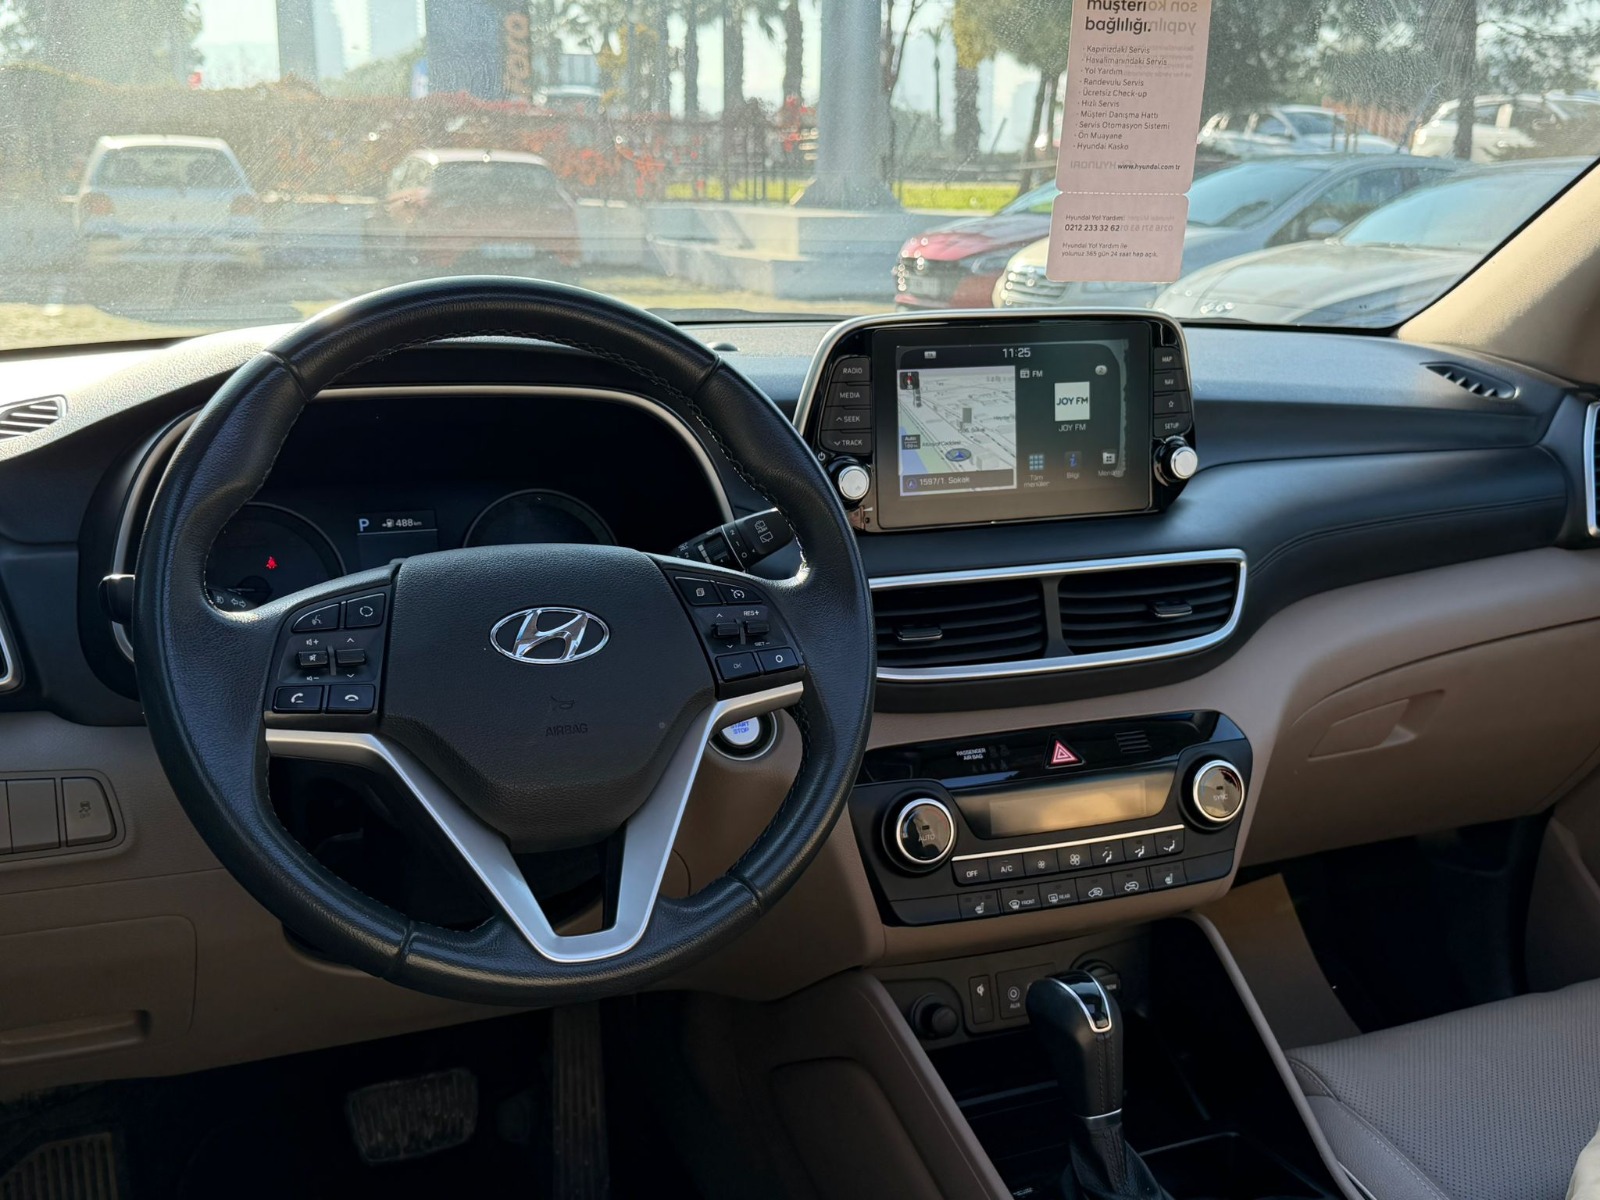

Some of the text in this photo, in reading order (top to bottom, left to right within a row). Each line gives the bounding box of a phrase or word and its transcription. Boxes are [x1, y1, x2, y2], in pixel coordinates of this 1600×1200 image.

[1085, 16, 1151, 35] bağlılığı.
[1129, 46, 1150, 54] Servis
[1146, 57, 1167, 66] Servis
[1084, 67, 1096, 75] Yol
[1097, 67, 1123, 75] Yardım
[1083, 78, 1121, 86] Randevulu
[1079, 120, 1170, 130] Servis Otomasyon Sistemi
[1064, 223, 1120, 232] 0212 233 32 62
[1002, 347, 1031, 358] 11:25
[842, 367, 863, 375] RADIO
[1032, 370, 1043, 378] FM
[1056, 396, 1089, 406] JOY FM
[1058, 423, 1087, 432] JOY FM
[1164, 422, 1179, 430] SETUP
[358, 518, 370, 532] P
[545, 722, 589, 737] AIRBAG
[732, 727, 750, 735] STOP
[956, 747, 987, 756] PASSENGER
[918, 832, 936, 842] AUTO
[1000, 864, 1014, 874] A/C
[965, 869, 979, 879] OFF
